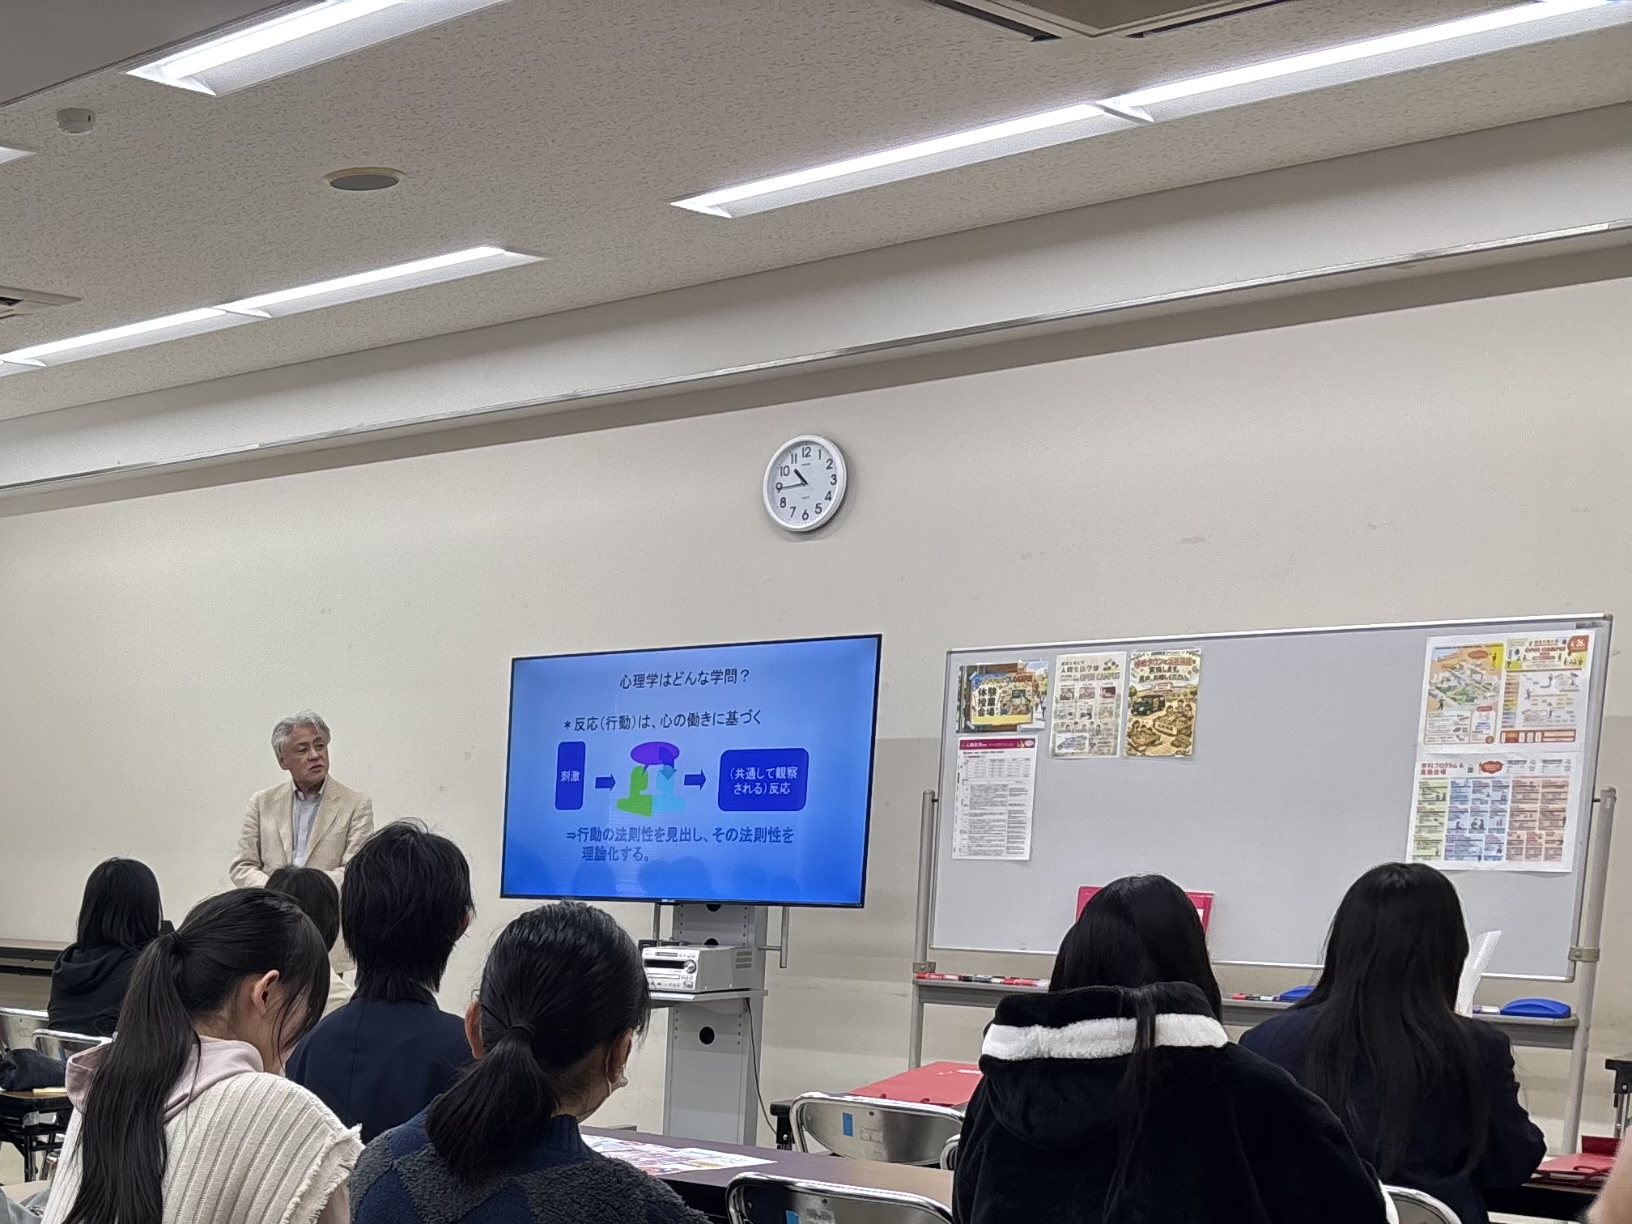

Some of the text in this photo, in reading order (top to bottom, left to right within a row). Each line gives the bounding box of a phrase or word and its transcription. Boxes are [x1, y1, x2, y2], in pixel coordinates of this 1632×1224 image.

[802, 447, 812, 458] 12
[818, 449, 822, 460] 1
[791, 453, 798, 464] 11
[826, 458, 834, 470] 2
[780, 465, 790, 477] 10
[830, 474, 838, 485] 3
[775, 482, 783, 493] 9
[824, 490, 832, 501] 4
[780, 497, 787, 508] 8
[790, 506, 797, 518] 7
[814, 503, 822, 514] 5
[801, 509, 809, 520] 6
[620, 668, 750, 690] 心理学はどんな学問？
[730, 766, 799, 780] （共通して観察
[733, 781, 791, 796] される）反応
[581, 845, 649, 862] 理論化する。
